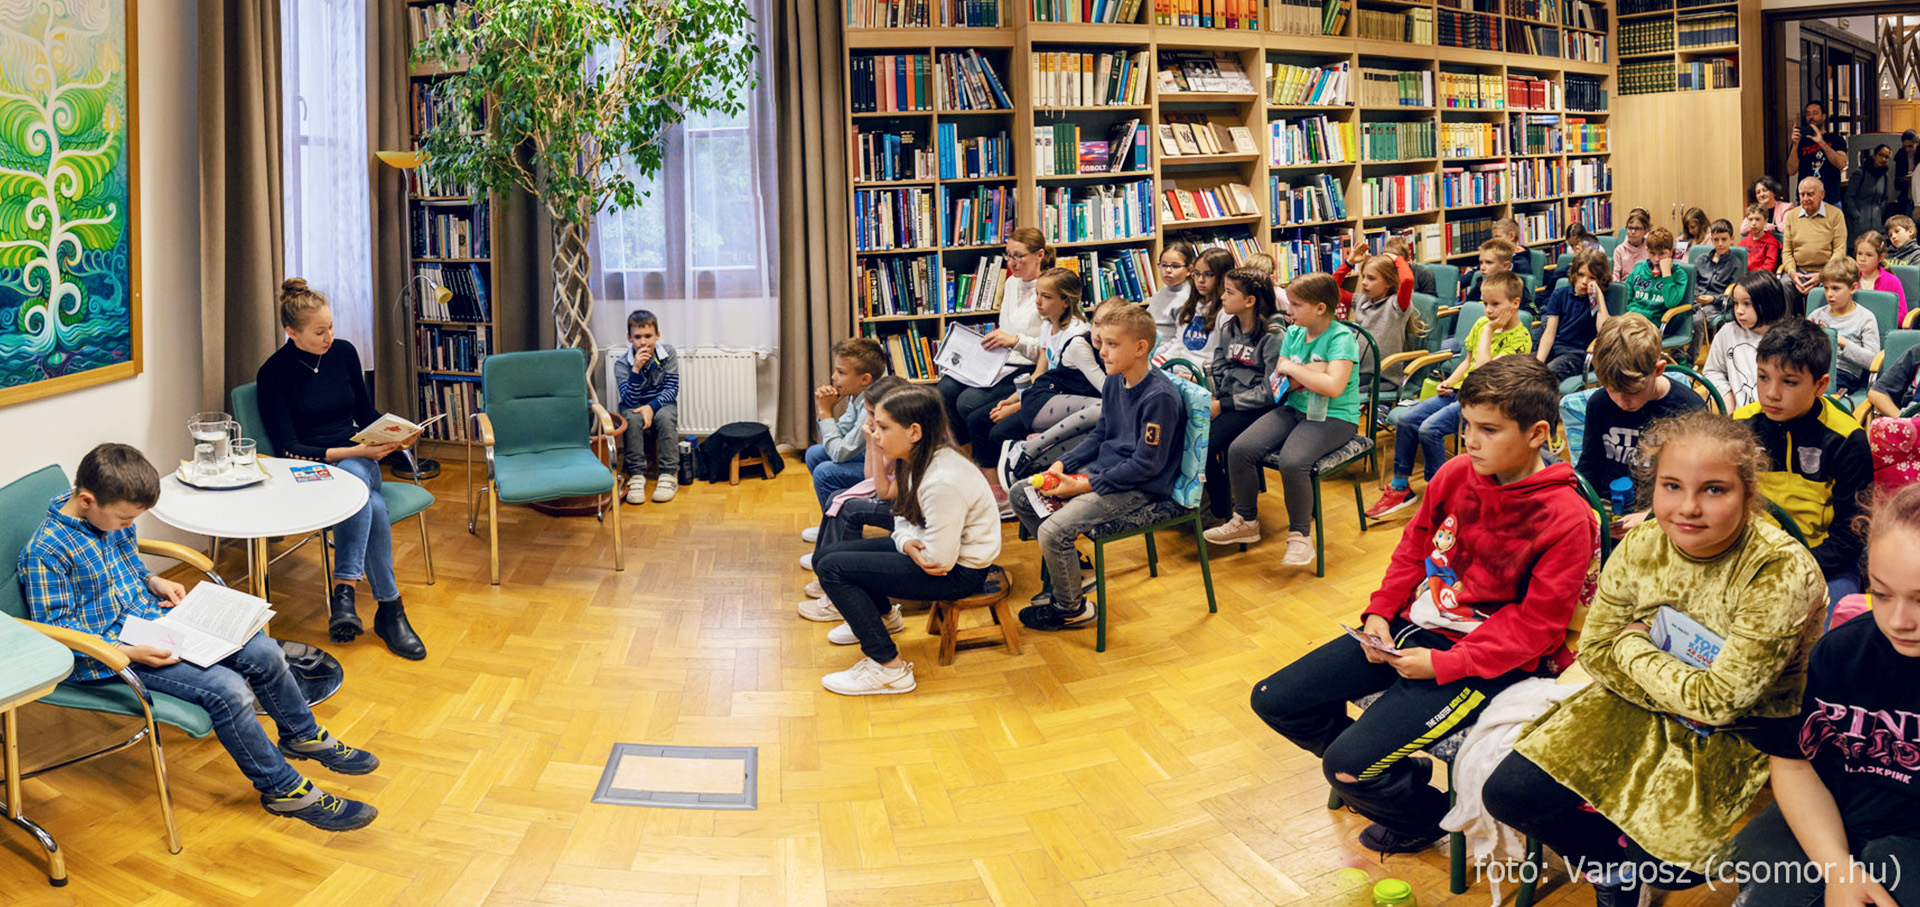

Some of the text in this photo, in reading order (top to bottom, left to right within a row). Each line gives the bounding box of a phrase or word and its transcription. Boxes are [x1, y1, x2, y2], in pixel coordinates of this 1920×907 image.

[1146, 426, 1156, 443] 3
[1688, 642, 1715, 662] KITÁL
[1694, 634, 1720, 655] TOD
[1697, 654, 1712, 664] OVI
[1425, 717, 1438, 728] THE
[1434, 705, 1453, 722] FASTER
[1814, 697, 1920, 742] PIN
